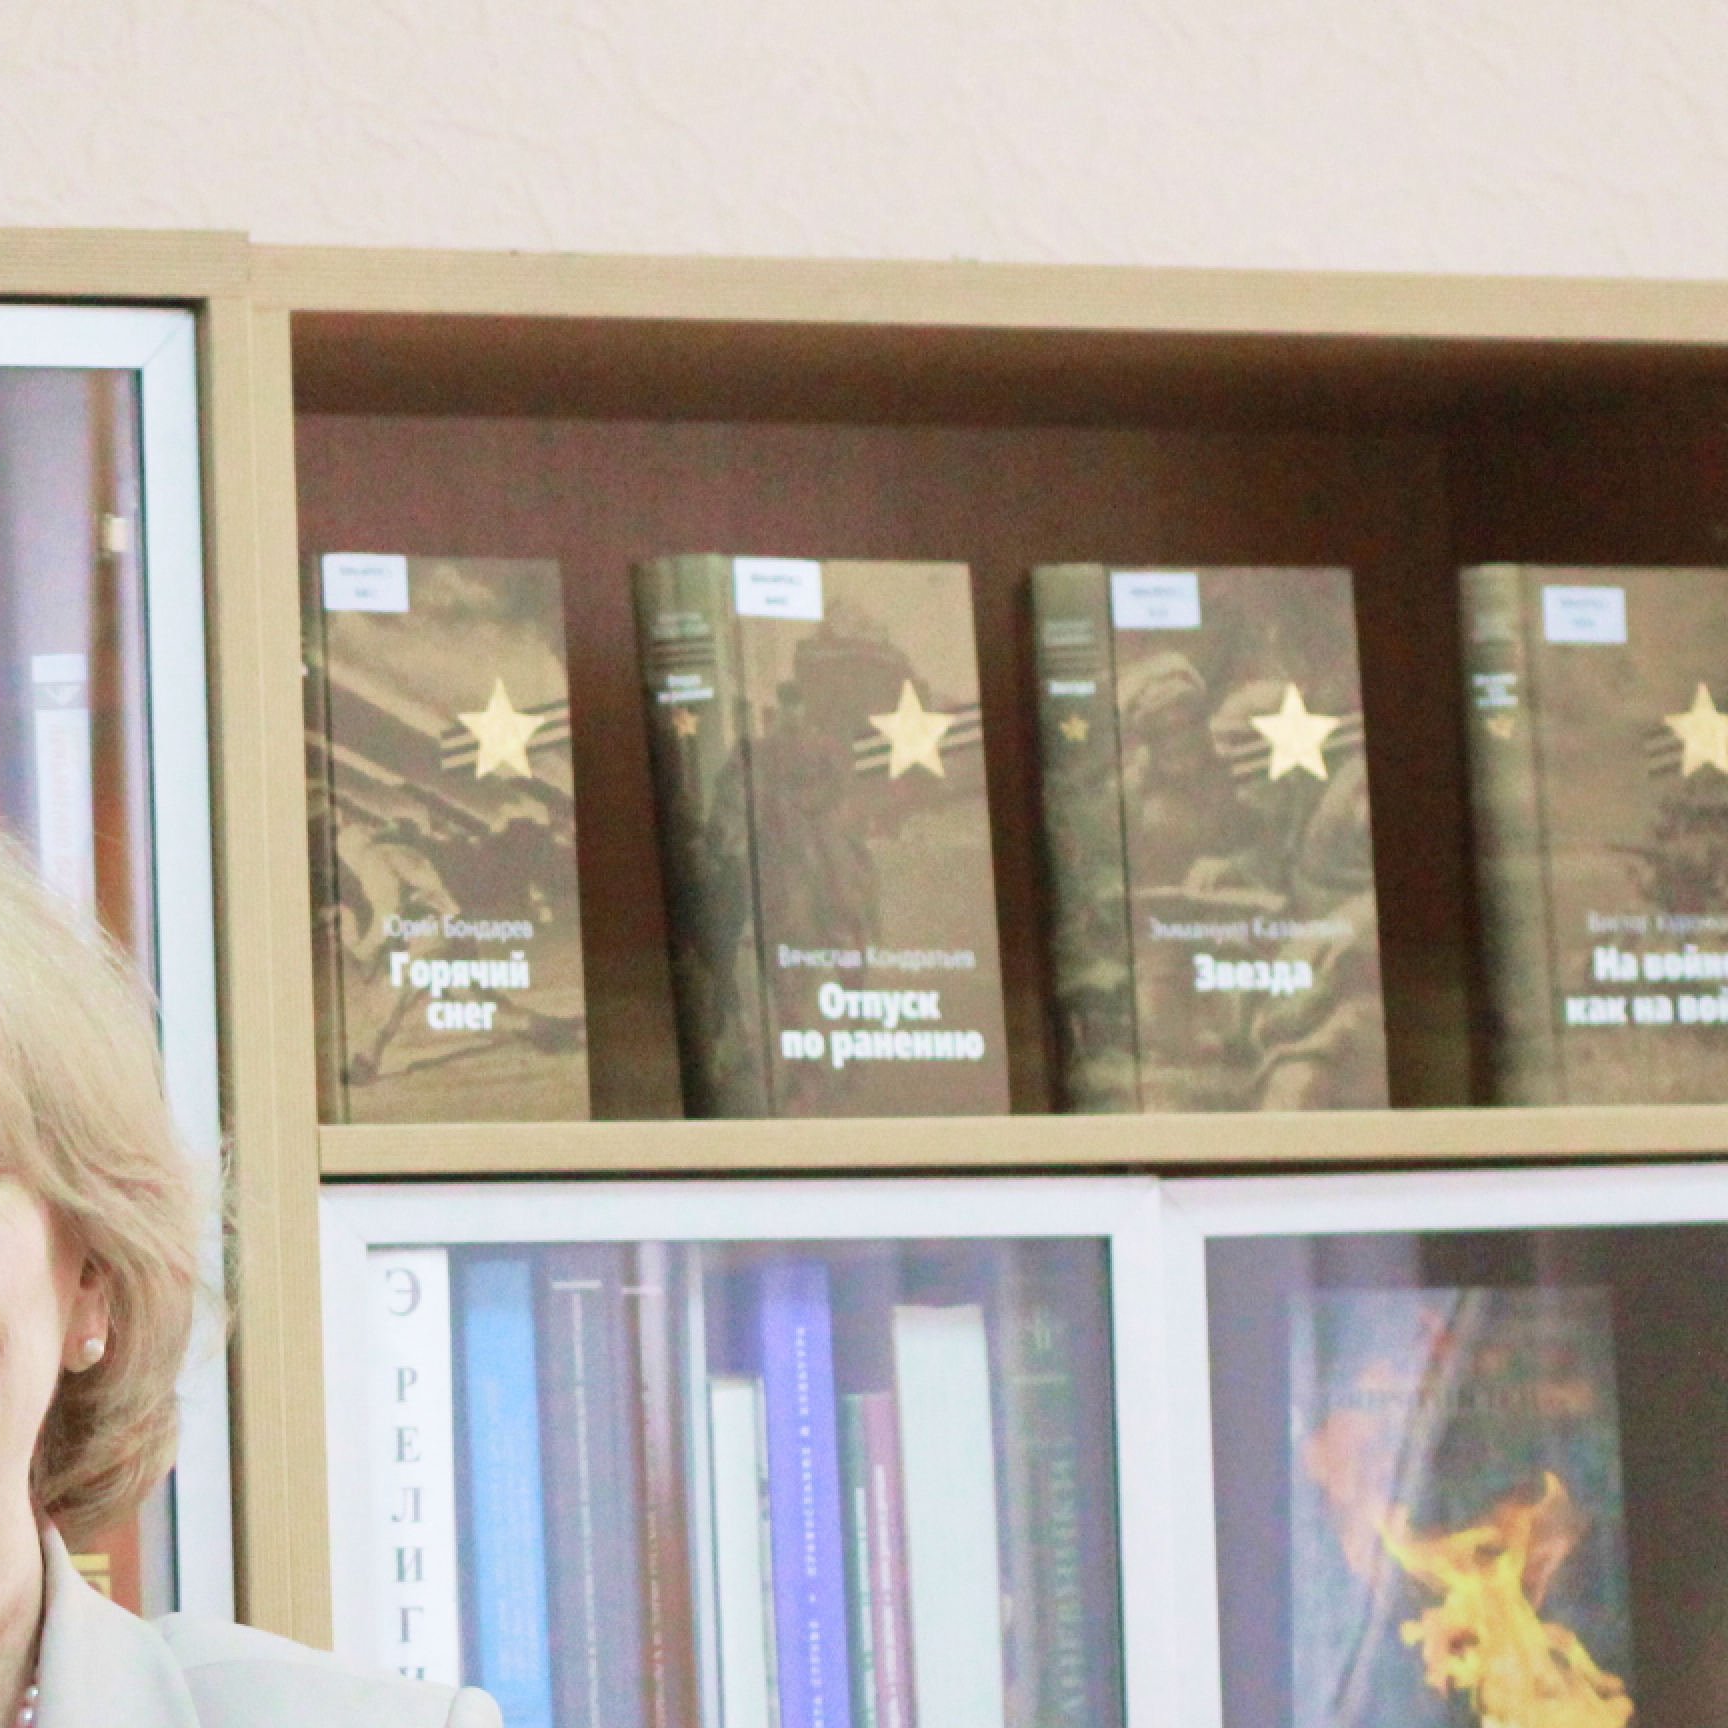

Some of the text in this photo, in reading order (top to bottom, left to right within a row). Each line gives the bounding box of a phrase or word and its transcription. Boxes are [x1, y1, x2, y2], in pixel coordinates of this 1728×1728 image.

[389, 950, 531, 998] Горячий
[1192, 951, 1313, 997] Звезда
[1594, 945, 1639, 982] На
[426, 1001, 498, 1031] снег
[818, 981, 942, 1029] Отпуск
[1566, 995, 1628, 1026] как
[1632, 995, 1674, 1026] на
[781, 1030, 986, 1070] по ранению
[385, 1267, 422, 1317] Э
